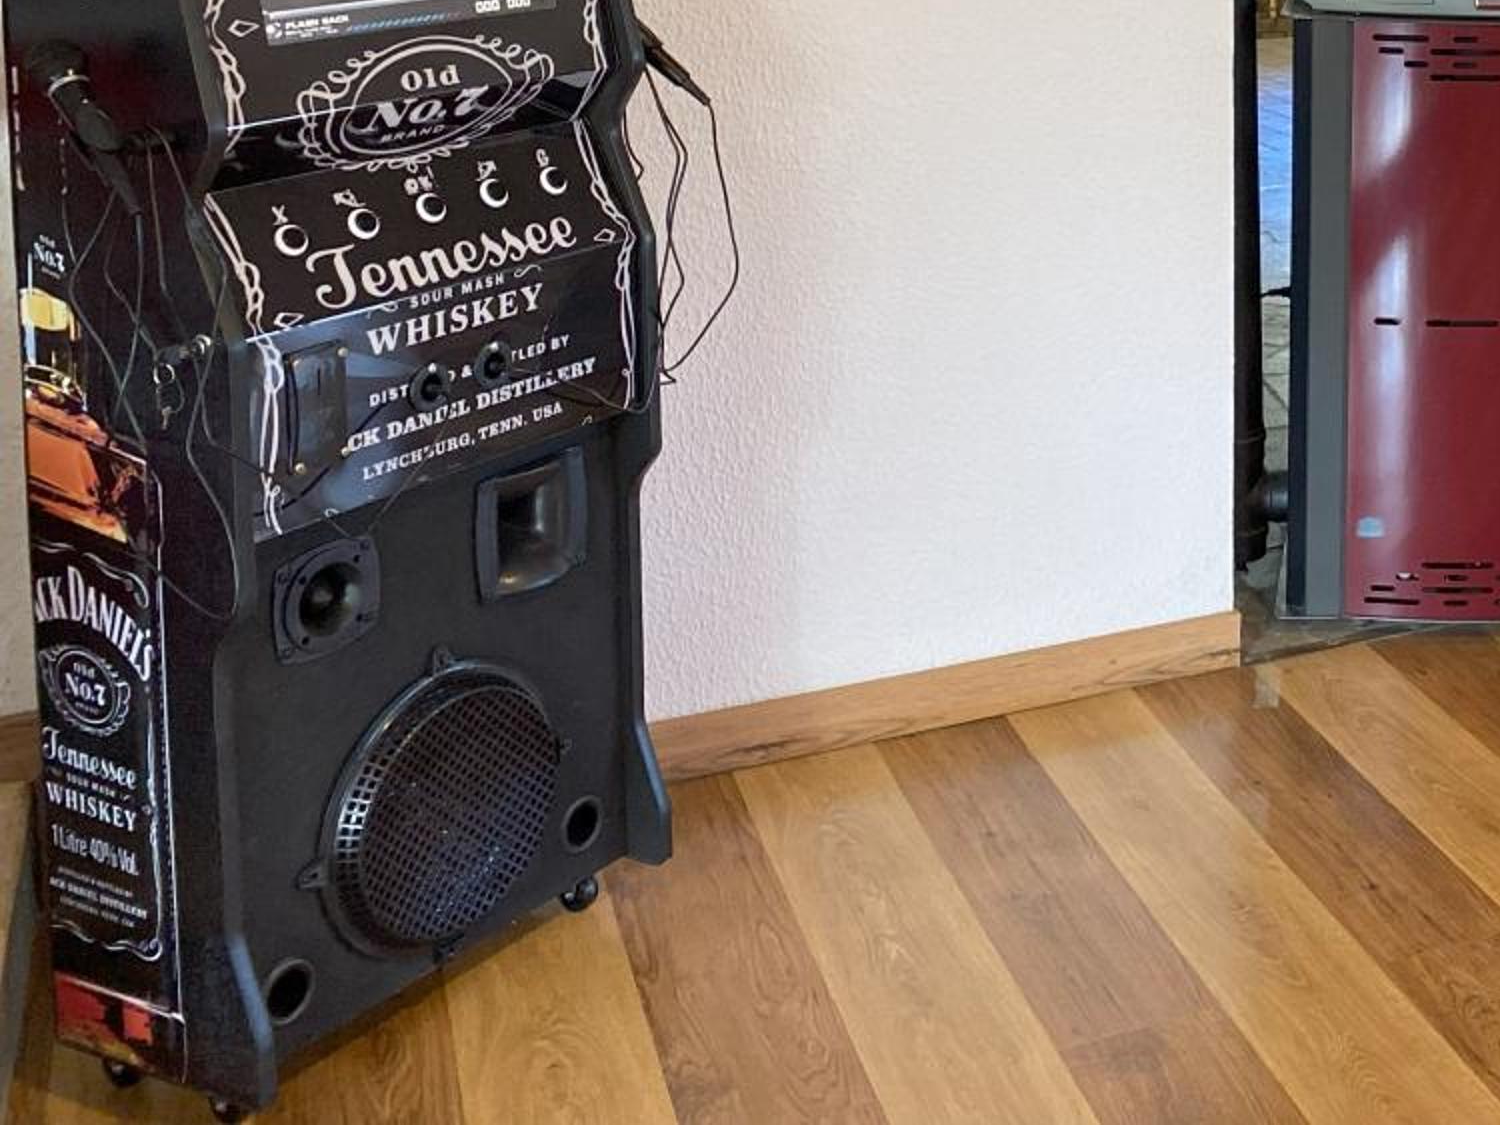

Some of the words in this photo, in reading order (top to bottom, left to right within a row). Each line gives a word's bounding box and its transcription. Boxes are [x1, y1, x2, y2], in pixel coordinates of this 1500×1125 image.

[401, 64, 461, 92] Old
[305, 216, 577, 309] Tennessee
[410, 287, 453, 309] SOUR
[461, 272, 505, 296] MASH
[366, 283, 543, 356] WHISKEY
[551, 334, 570, 351] BY
[478, 414, 528, 440] TENN.
[532, 401, 563, 422] USA
[42, 726, 136, 790] Tennessee
[46, 781, 137, 833] WHISKEY
